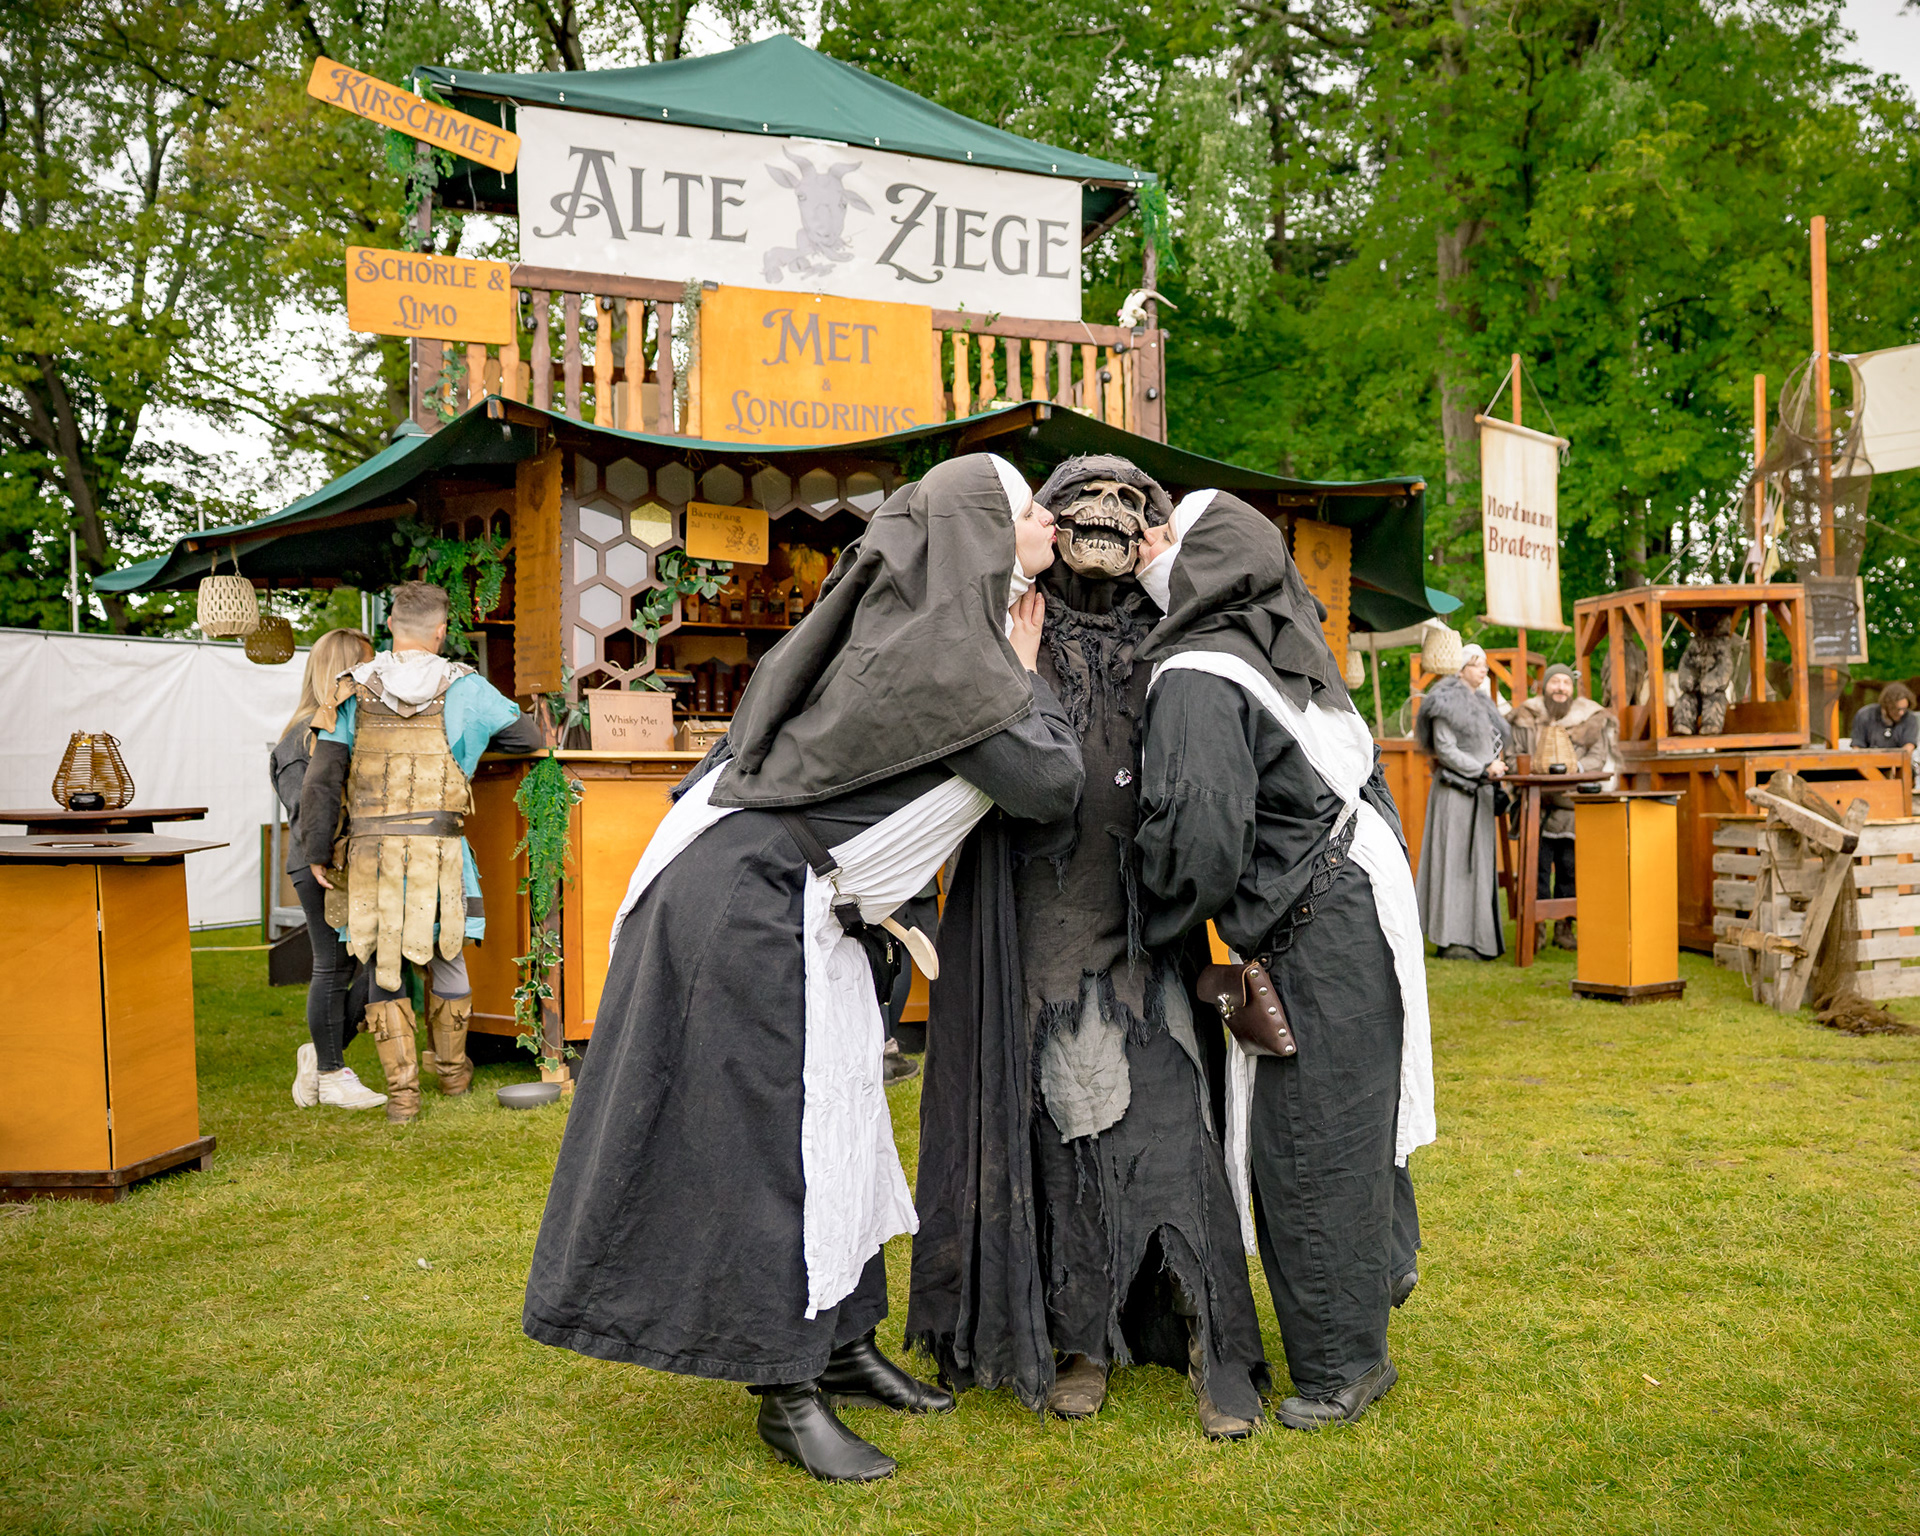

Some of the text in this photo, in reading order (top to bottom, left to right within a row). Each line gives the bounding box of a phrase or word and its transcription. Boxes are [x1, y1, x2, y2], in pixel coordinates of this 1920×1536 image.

[326, 68, 506, 160] KIRSCHMET
[533, 145, 1071, 284] ALTE ZIEGE
[354, 250, 505, 291] SCHORLE &
[393, 295, 457, 330] LIMO
[762, 308, 878, 366] MET
[821, 378, 831, 391] &
[725, 389, 917, 435] LONGDRINKS
[604, 714, 658, 726] Whisky Met
